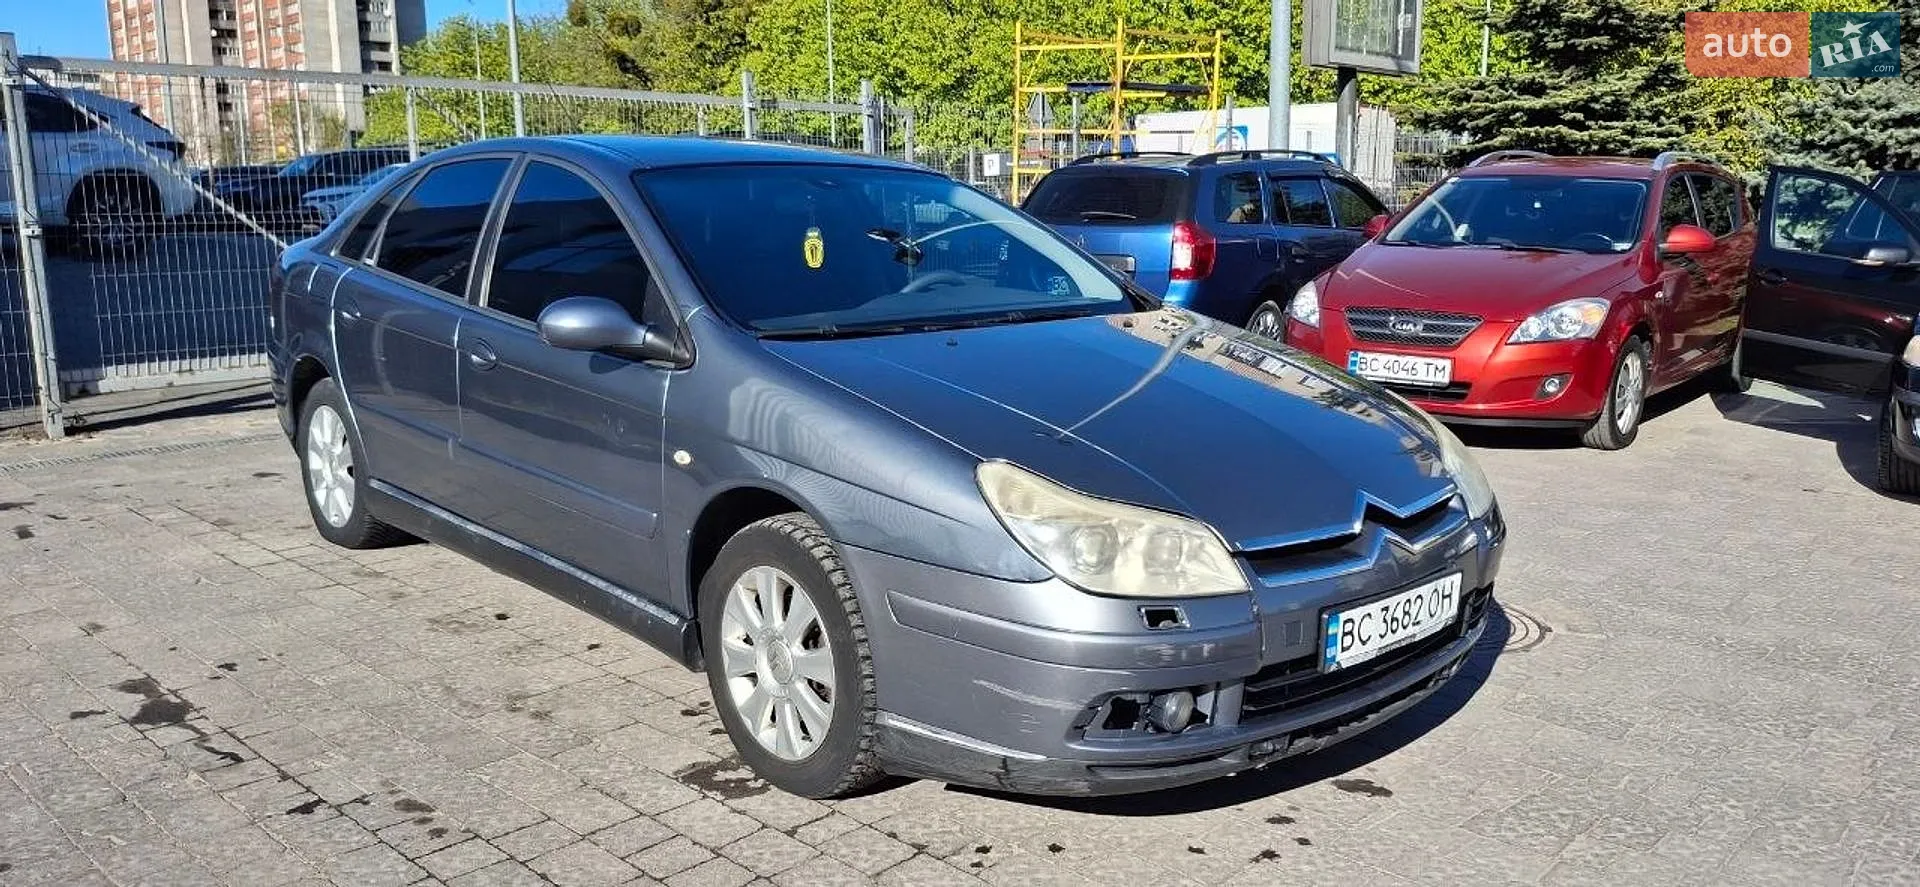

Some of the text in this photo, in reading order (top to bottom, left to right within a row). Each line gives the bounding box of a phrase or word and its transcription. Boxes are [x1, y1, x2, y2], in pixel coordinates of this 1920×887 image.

[1358, 357, 1446, 379] BC 4046 TM
[1341, 612, 1373, 652] BC
[1378, 594, 1424, 639] 3682
[1428, 580, 1455, 618] OH
